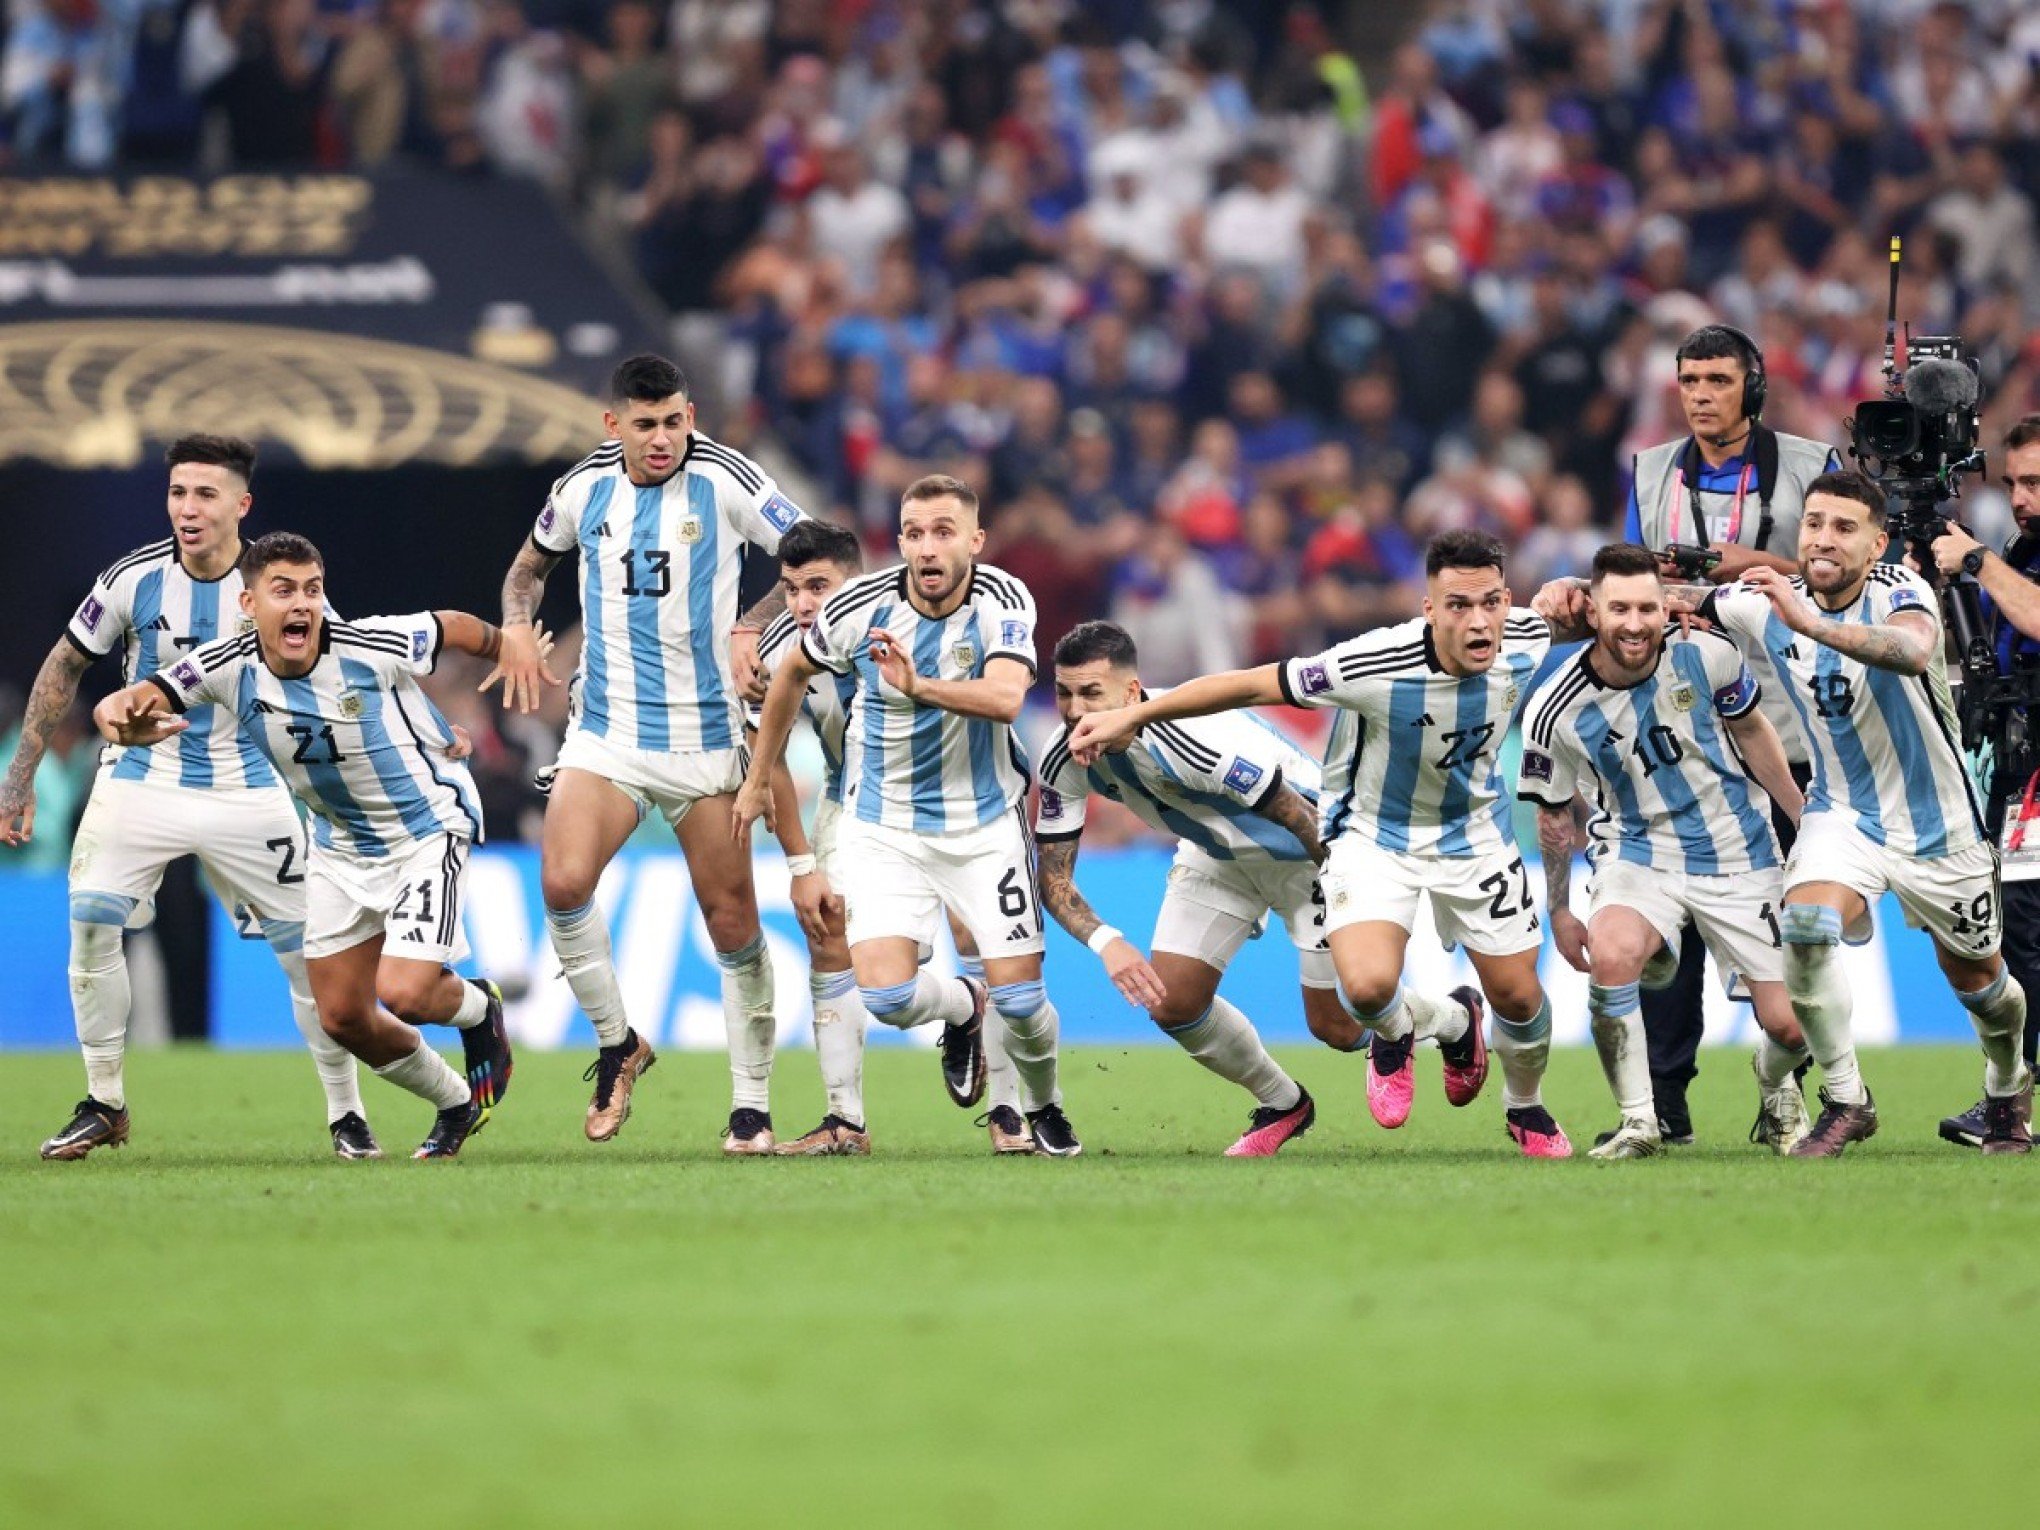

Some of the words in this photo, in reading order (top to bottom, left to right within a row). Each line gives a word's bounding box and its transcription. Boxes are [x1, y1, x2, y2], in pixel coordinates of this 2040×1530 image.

[620, 549, 670, 597] 13
[1807, 672, 1855, 717] 19
[286, 725, 347, 764] 21
[1435, 721, 1494, 769] 22
[1632, 725, 1683, 778] 10
[267, 836, 304, 884] 2
[392, 879, 434, 922] 21
[998, 867, 1026, 916] 6
[1479, 857, 1533, 918] 22
[1759, 902, 1783, 947] 1
[1951, 891, 1991, 934] 19
